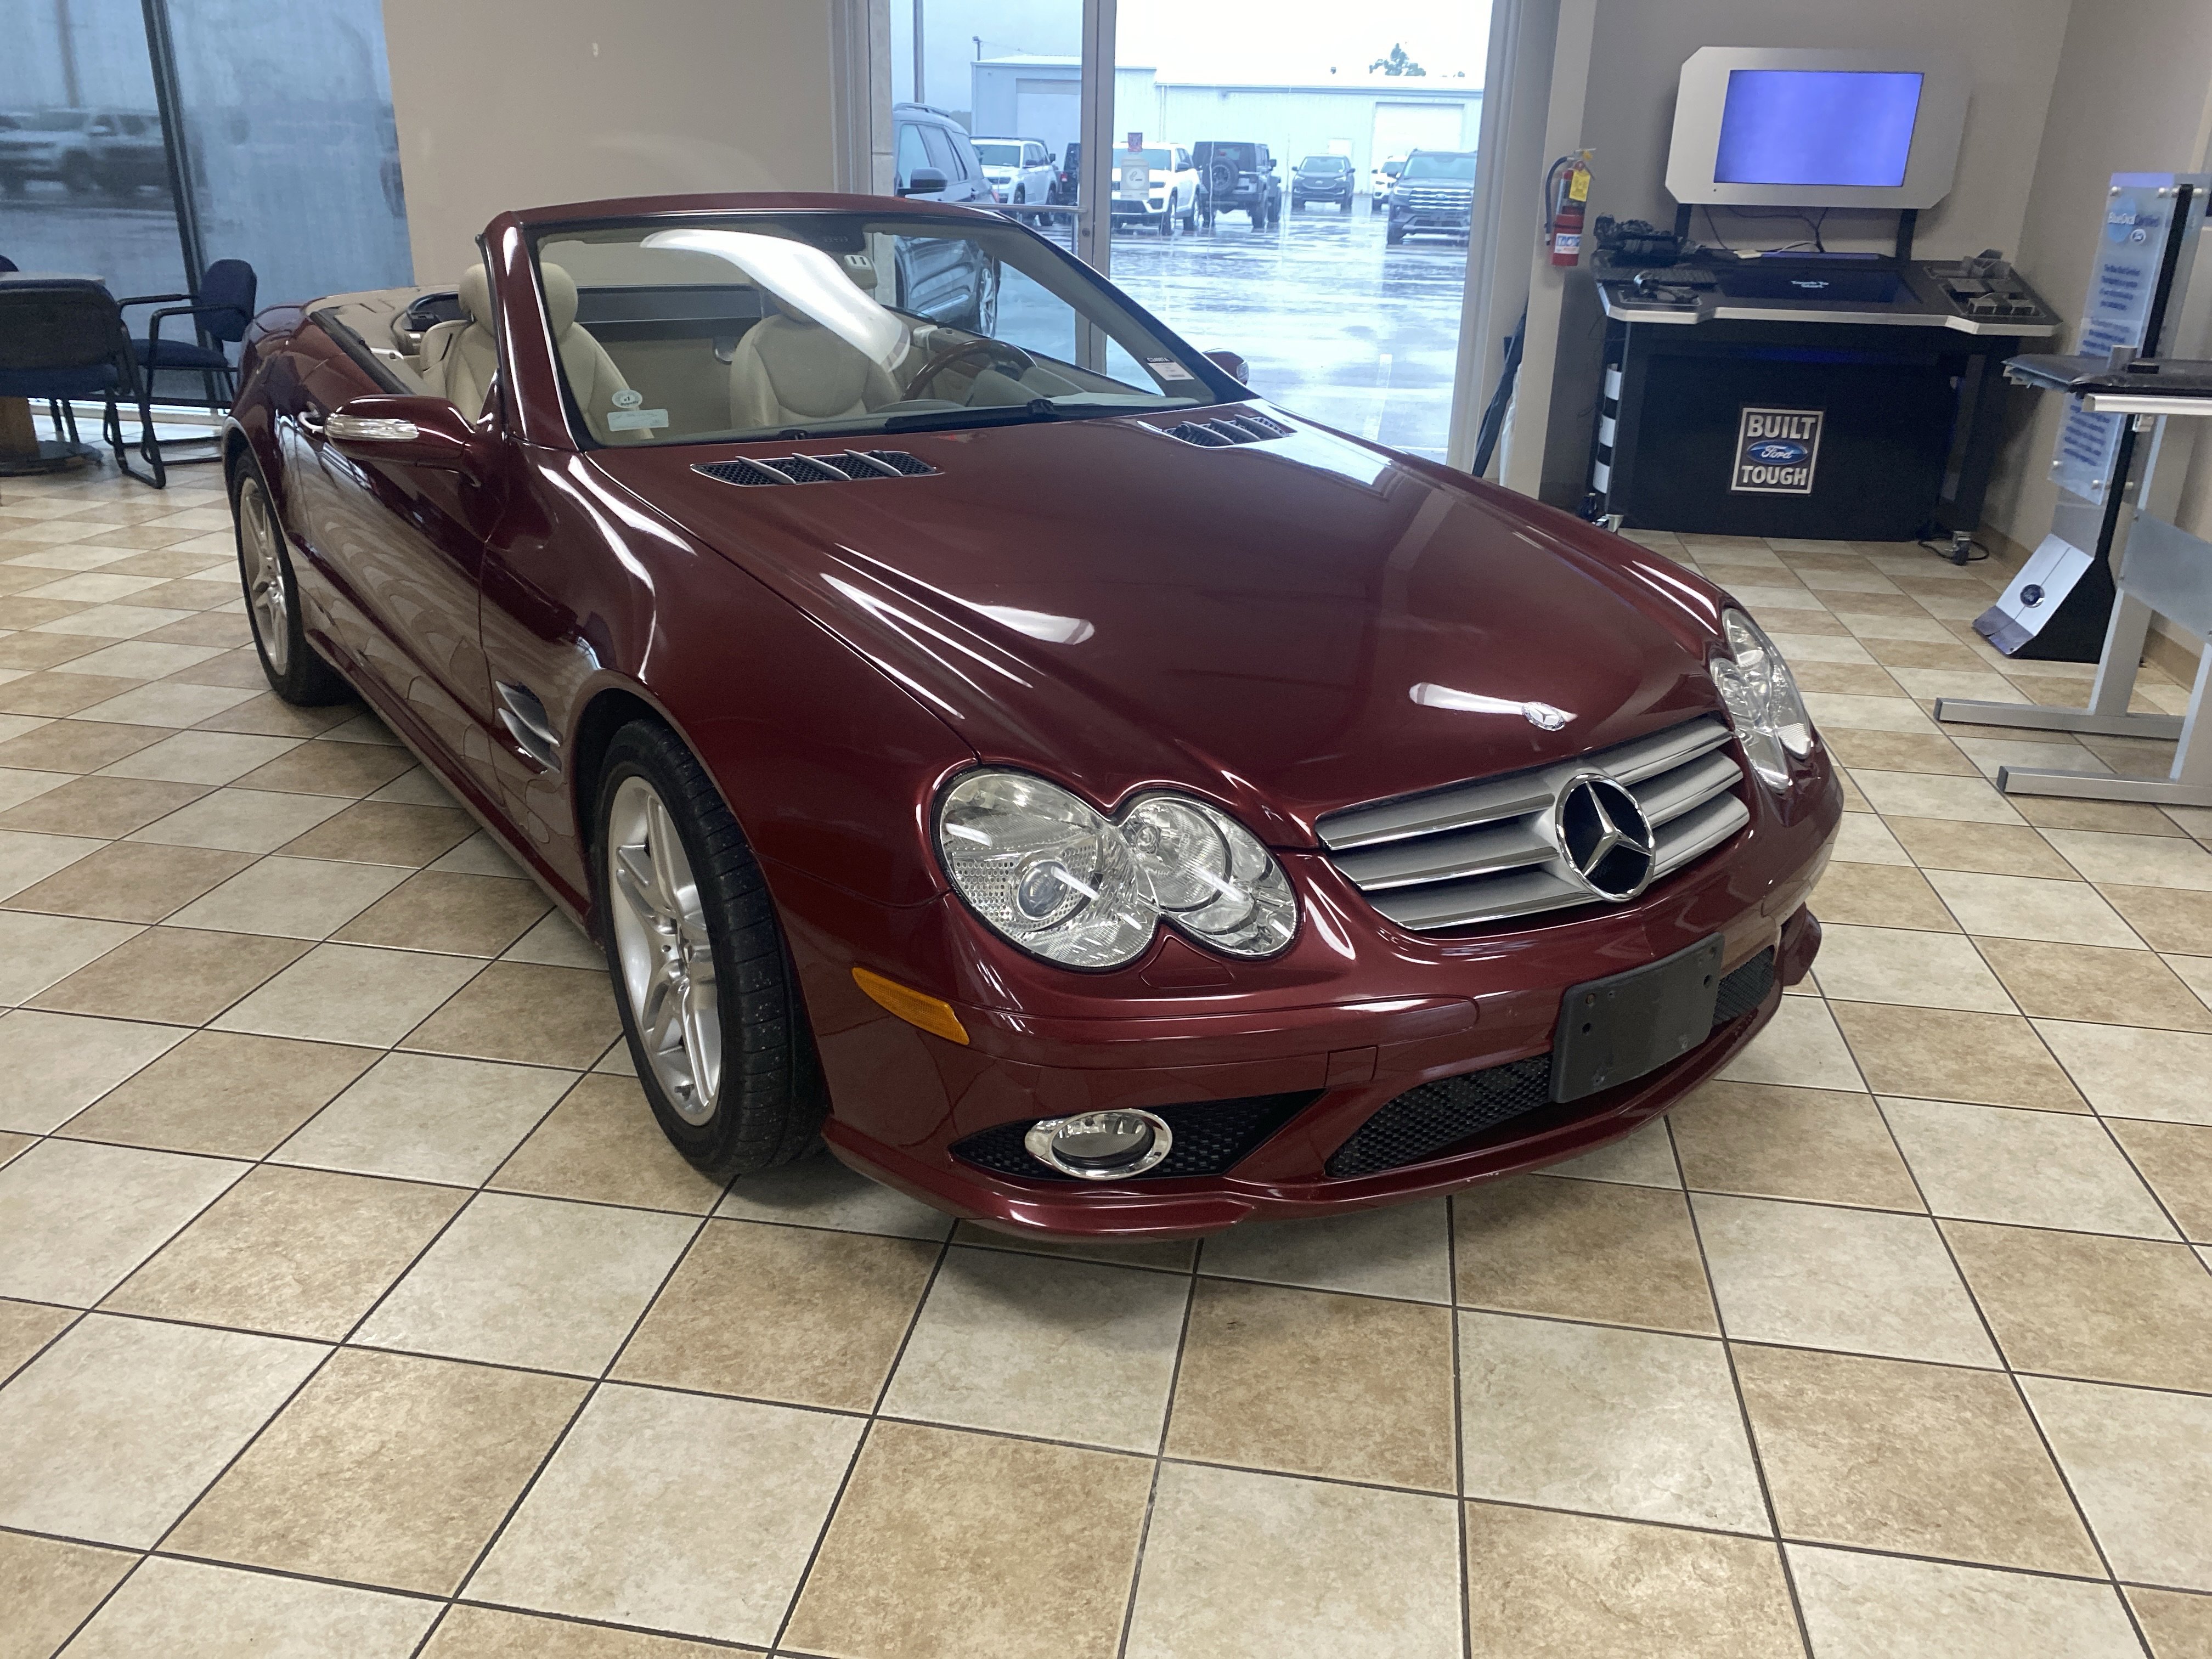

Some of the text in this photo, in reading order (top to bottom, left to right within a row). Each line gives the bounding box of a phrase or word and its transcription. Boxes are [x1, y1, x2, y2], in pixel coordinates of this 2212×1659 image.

[1747, 414, 1816, 439] BUILT
[1761, 445, 1795, 459] Ford
[1741, 465, 1808, 486] TOUGH
